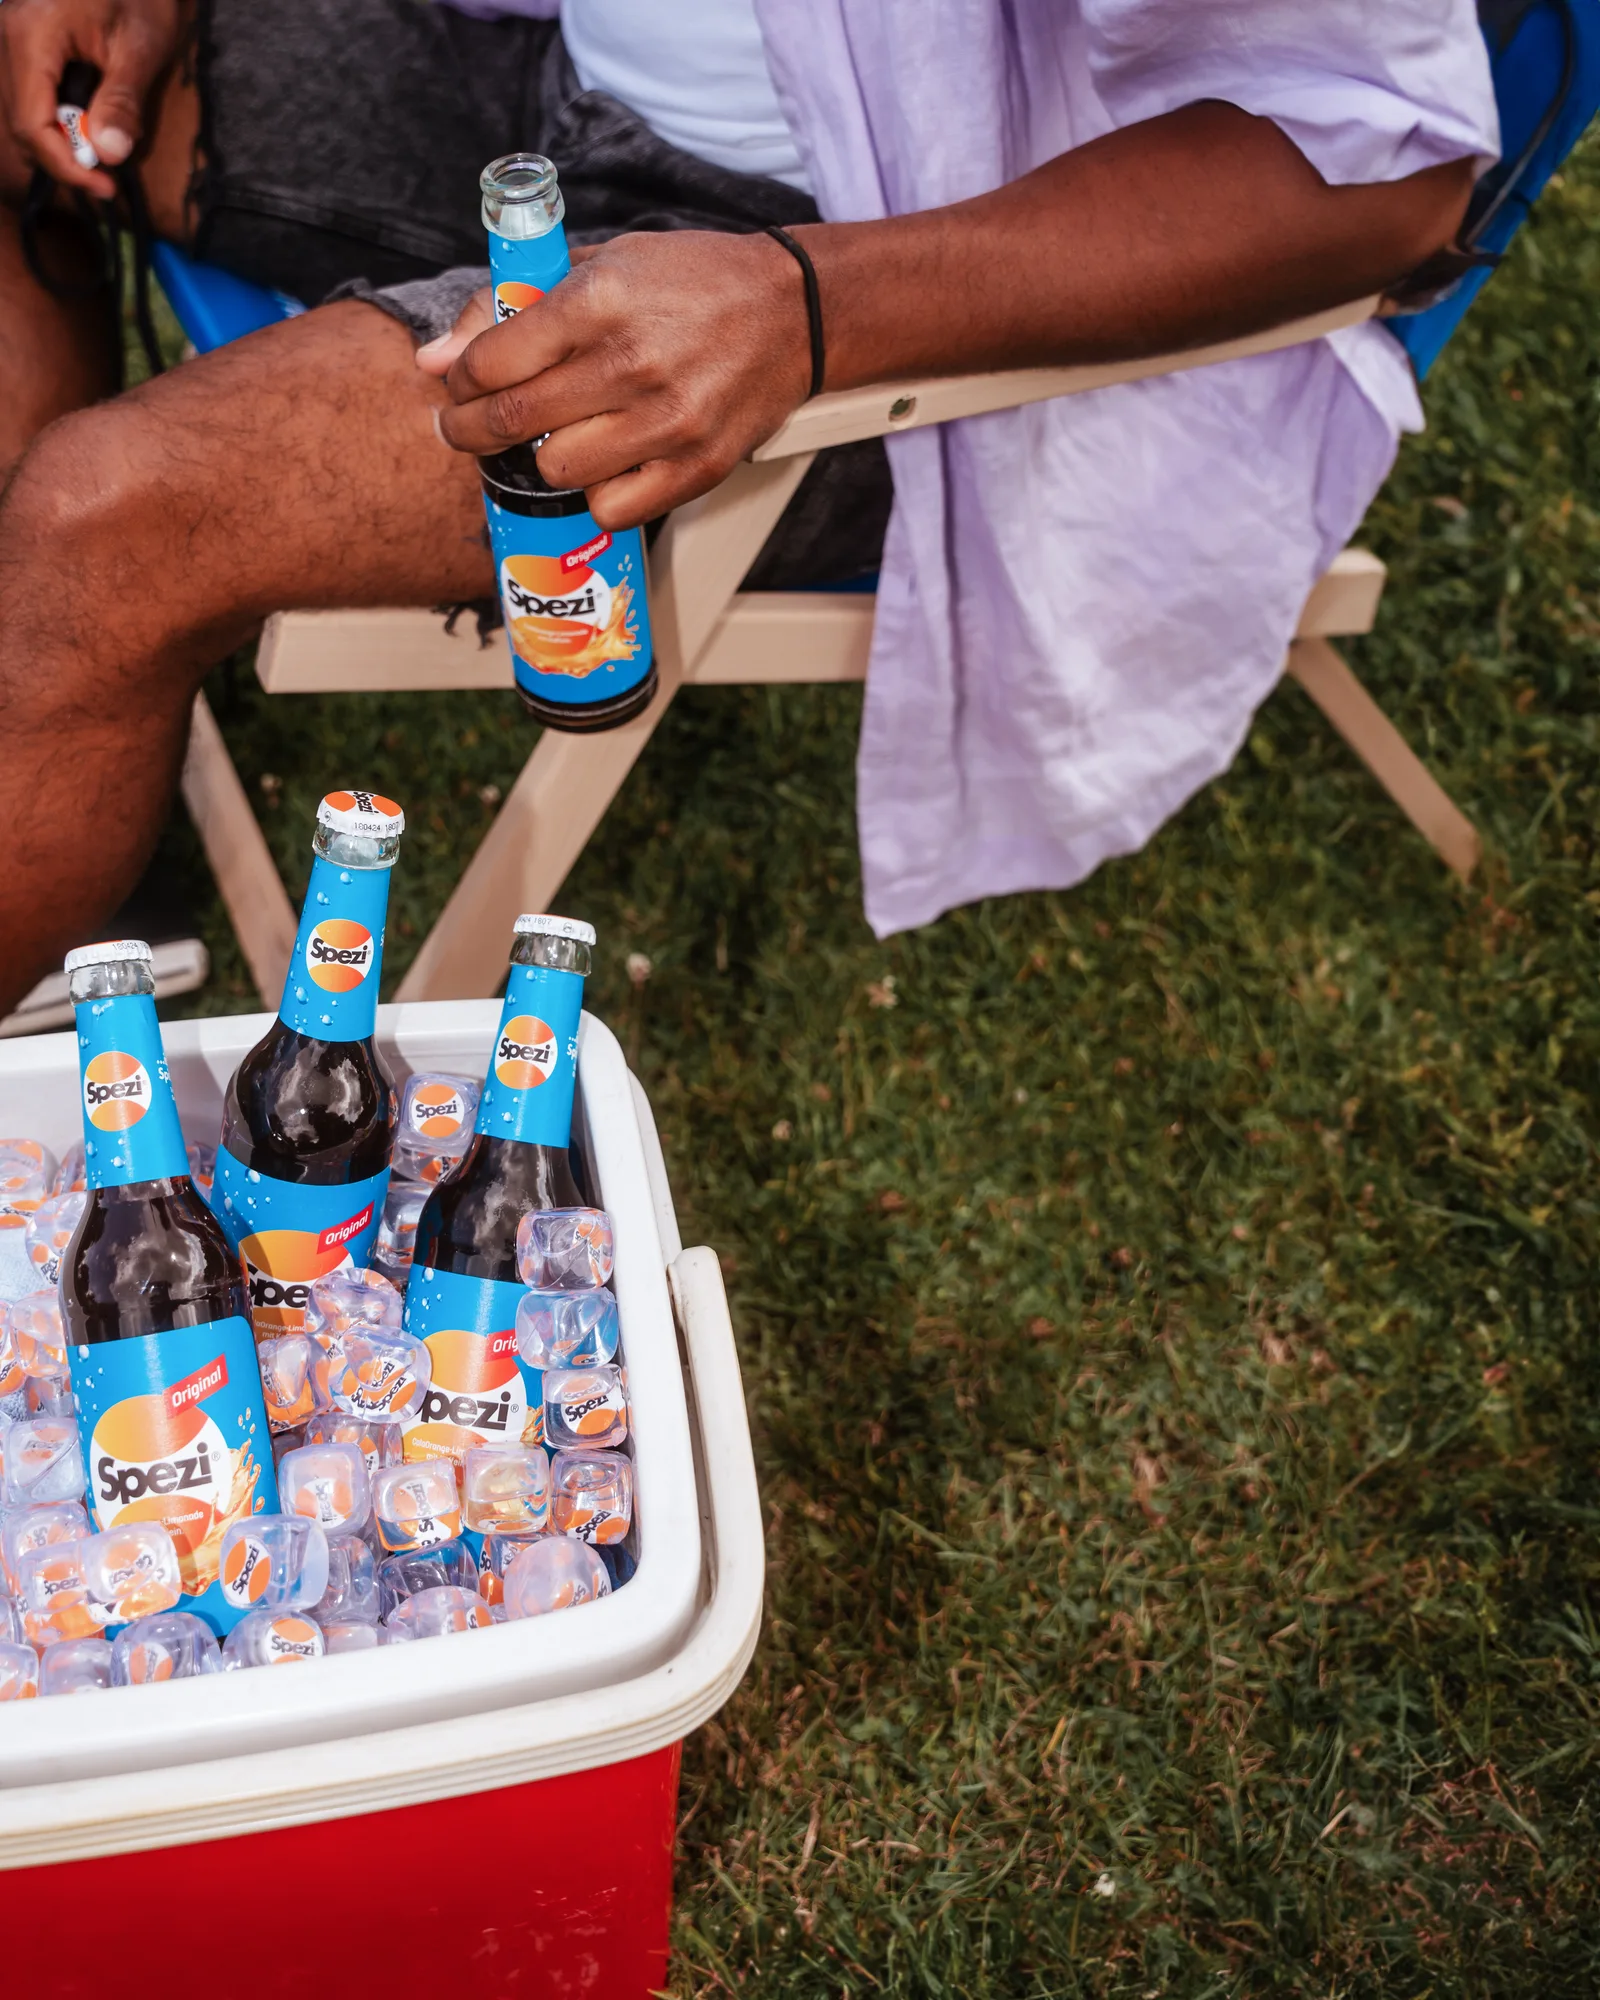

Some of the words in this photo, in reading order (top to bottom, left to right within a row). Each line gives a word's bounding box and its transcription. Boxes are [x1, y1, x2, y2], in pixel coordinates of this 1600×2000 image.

[565, 535, 608, 567] Original
[354, 822, 381, 832] 180424
[415, 1100, 458, 1118] Spezi
[325, 1210, 369, 1245] Original
[171, 1365, 222, 1409] Original
[231, 1544, 260, 1595] Spezi
